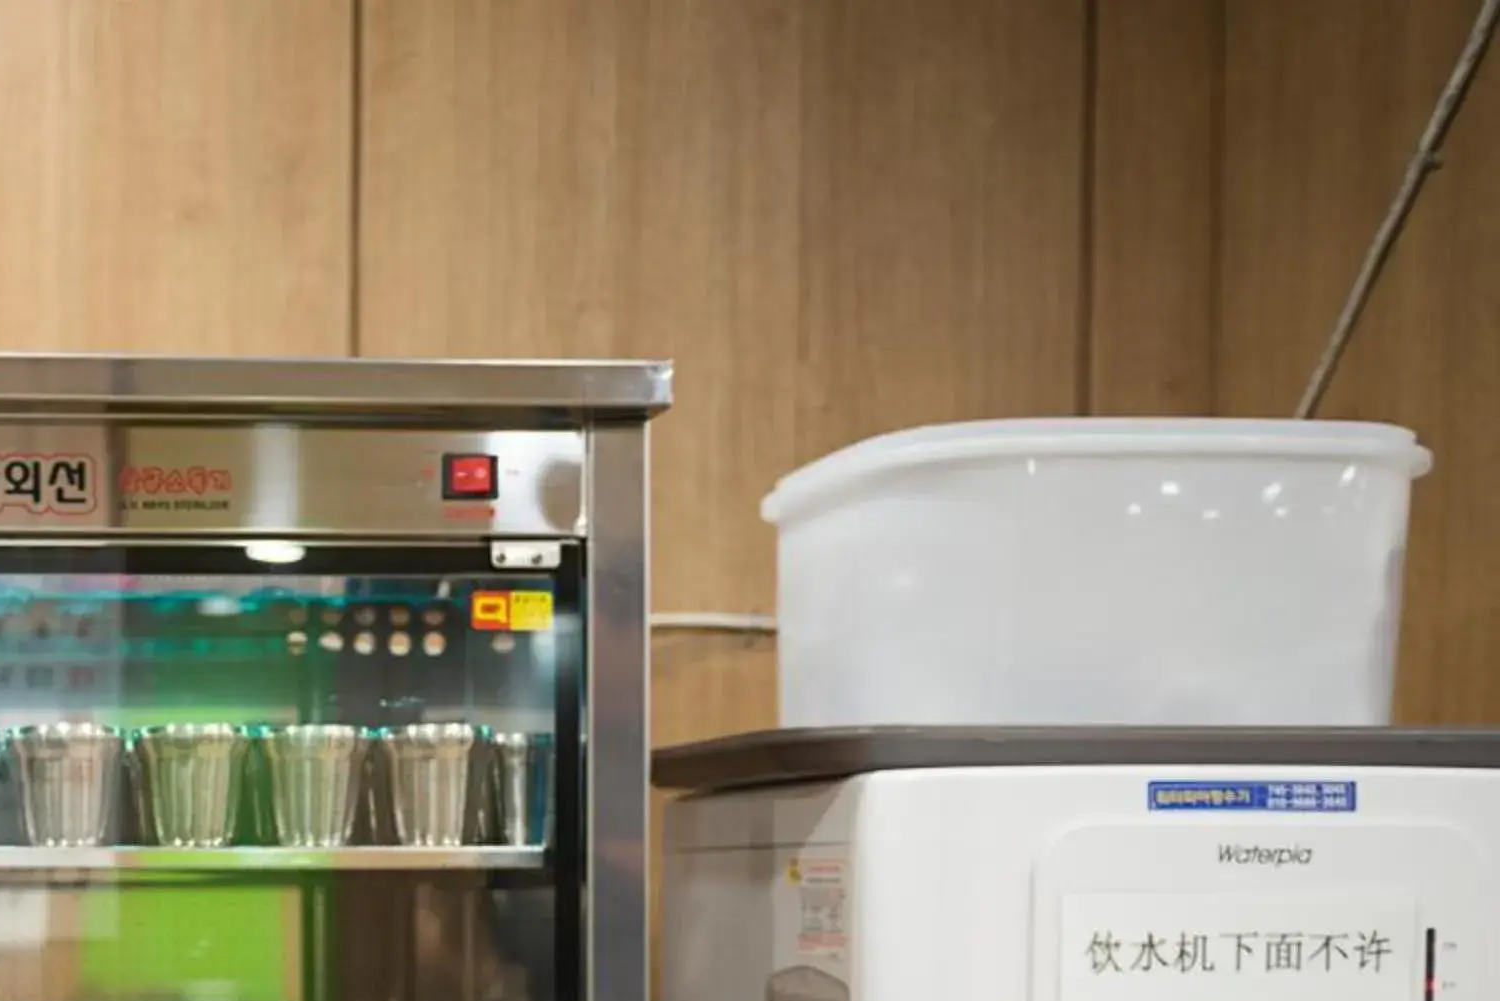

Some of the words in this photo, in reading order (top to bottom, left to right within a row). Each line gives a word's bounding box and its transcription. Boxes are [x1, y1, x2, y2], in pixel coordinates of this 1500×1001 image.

[1217, 843, 1313, 866] Waterpia
[1084, 928, 1393, 974] 饮水机下面不许
